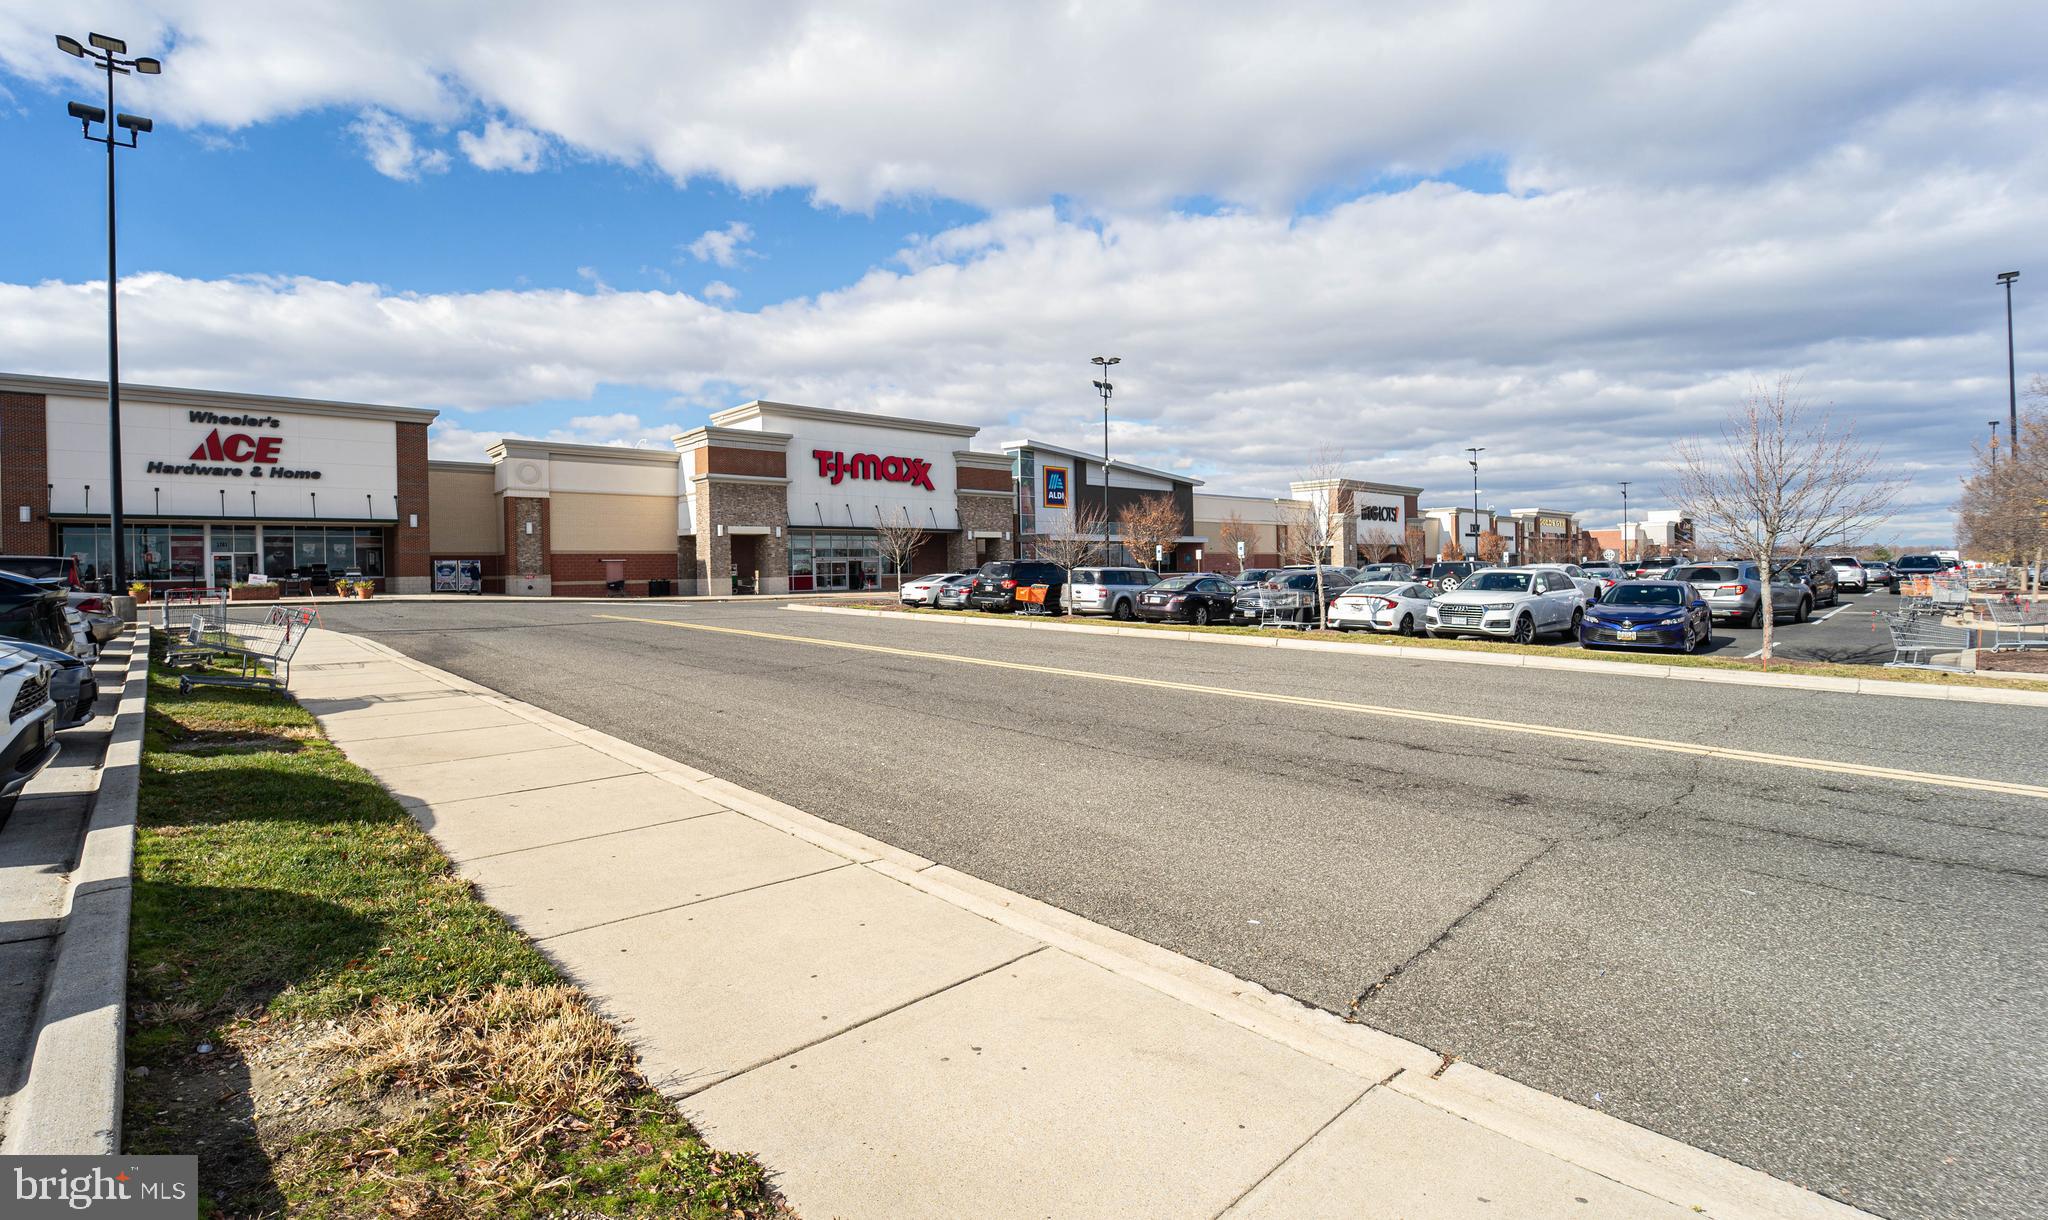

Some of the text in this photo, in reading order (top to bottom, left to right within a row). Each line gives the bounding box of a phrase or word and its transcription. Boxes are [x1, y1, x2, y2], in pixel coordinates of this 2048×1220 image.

[189, 410, 280, 428] Wheeler's
[189, 428, 283, 464] ACE
[147, 461, 322, 480] Hardware & Home
[1048, 491, 1065, 500] ALDI
